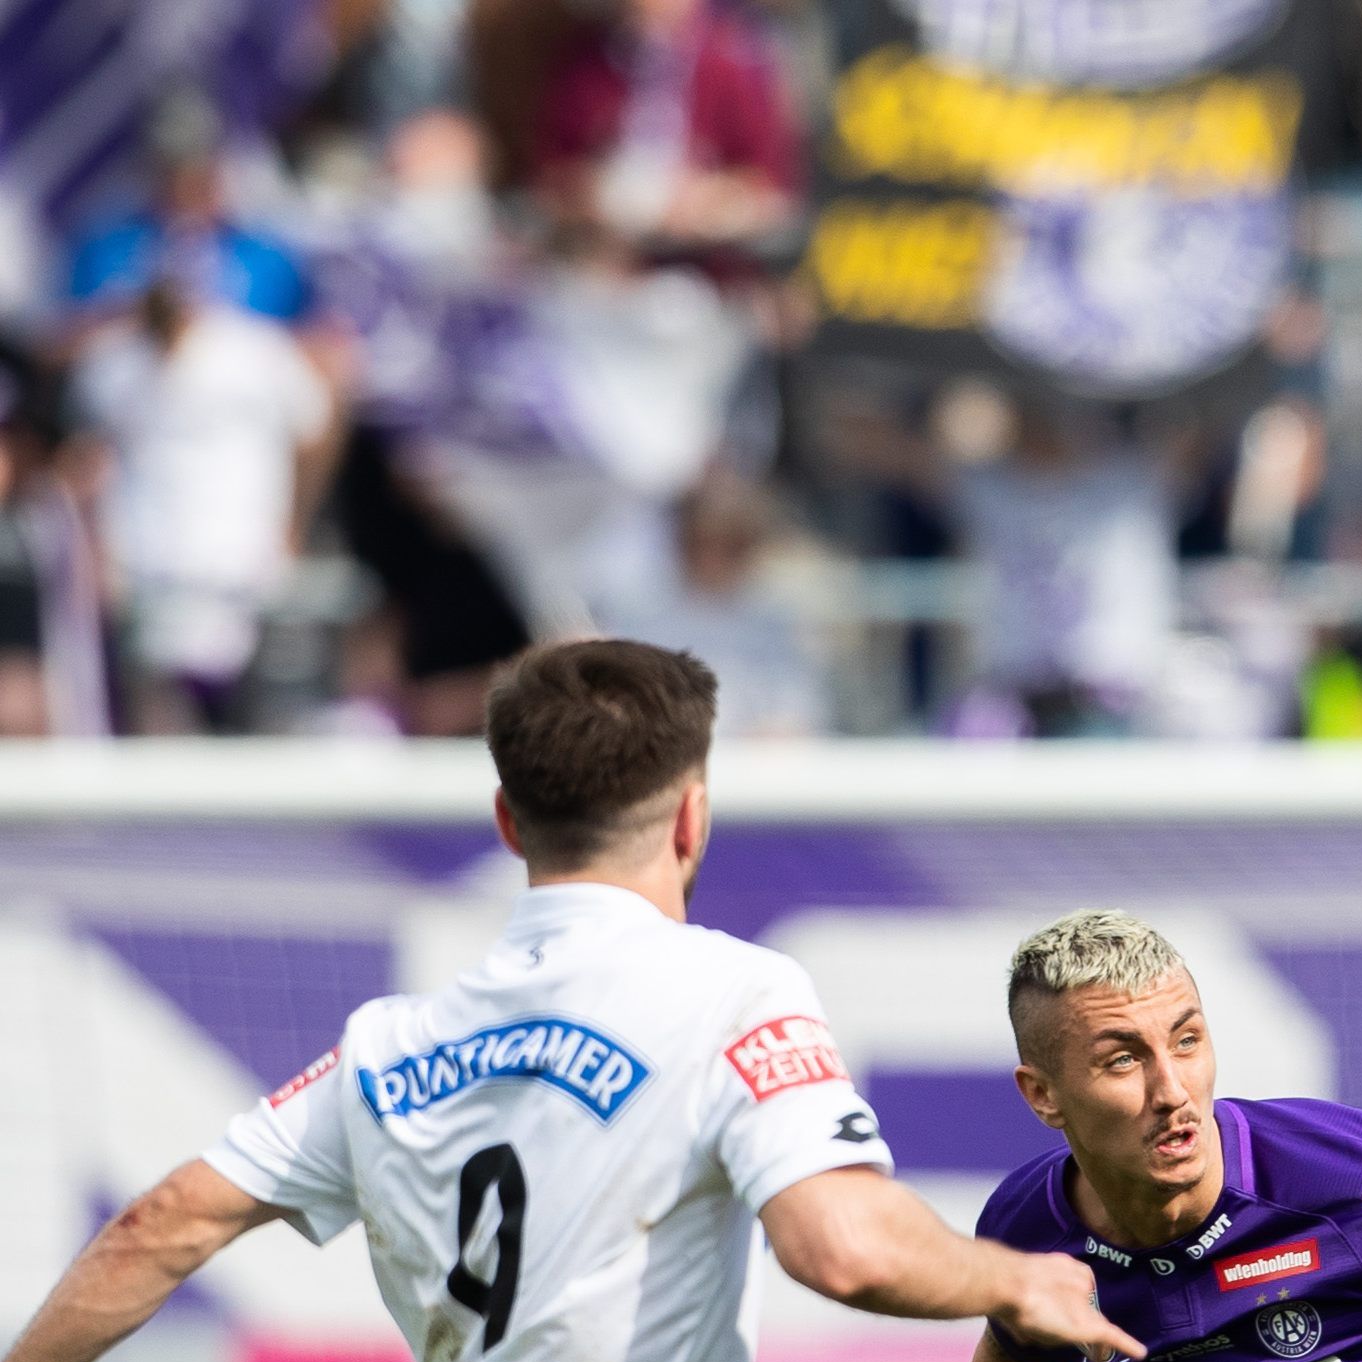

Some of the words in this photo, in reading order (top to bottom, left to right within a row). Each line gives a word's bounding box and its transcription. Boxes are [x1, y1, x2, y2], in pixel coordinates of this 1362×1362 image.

[374, 1025, 633, 1111] PUNTIGAMER
[447, 1142, 527, 1353] 9
[1098, 1244, 1133, 1268] BWT
[1197, 1213, 1233, 1249] BWT
